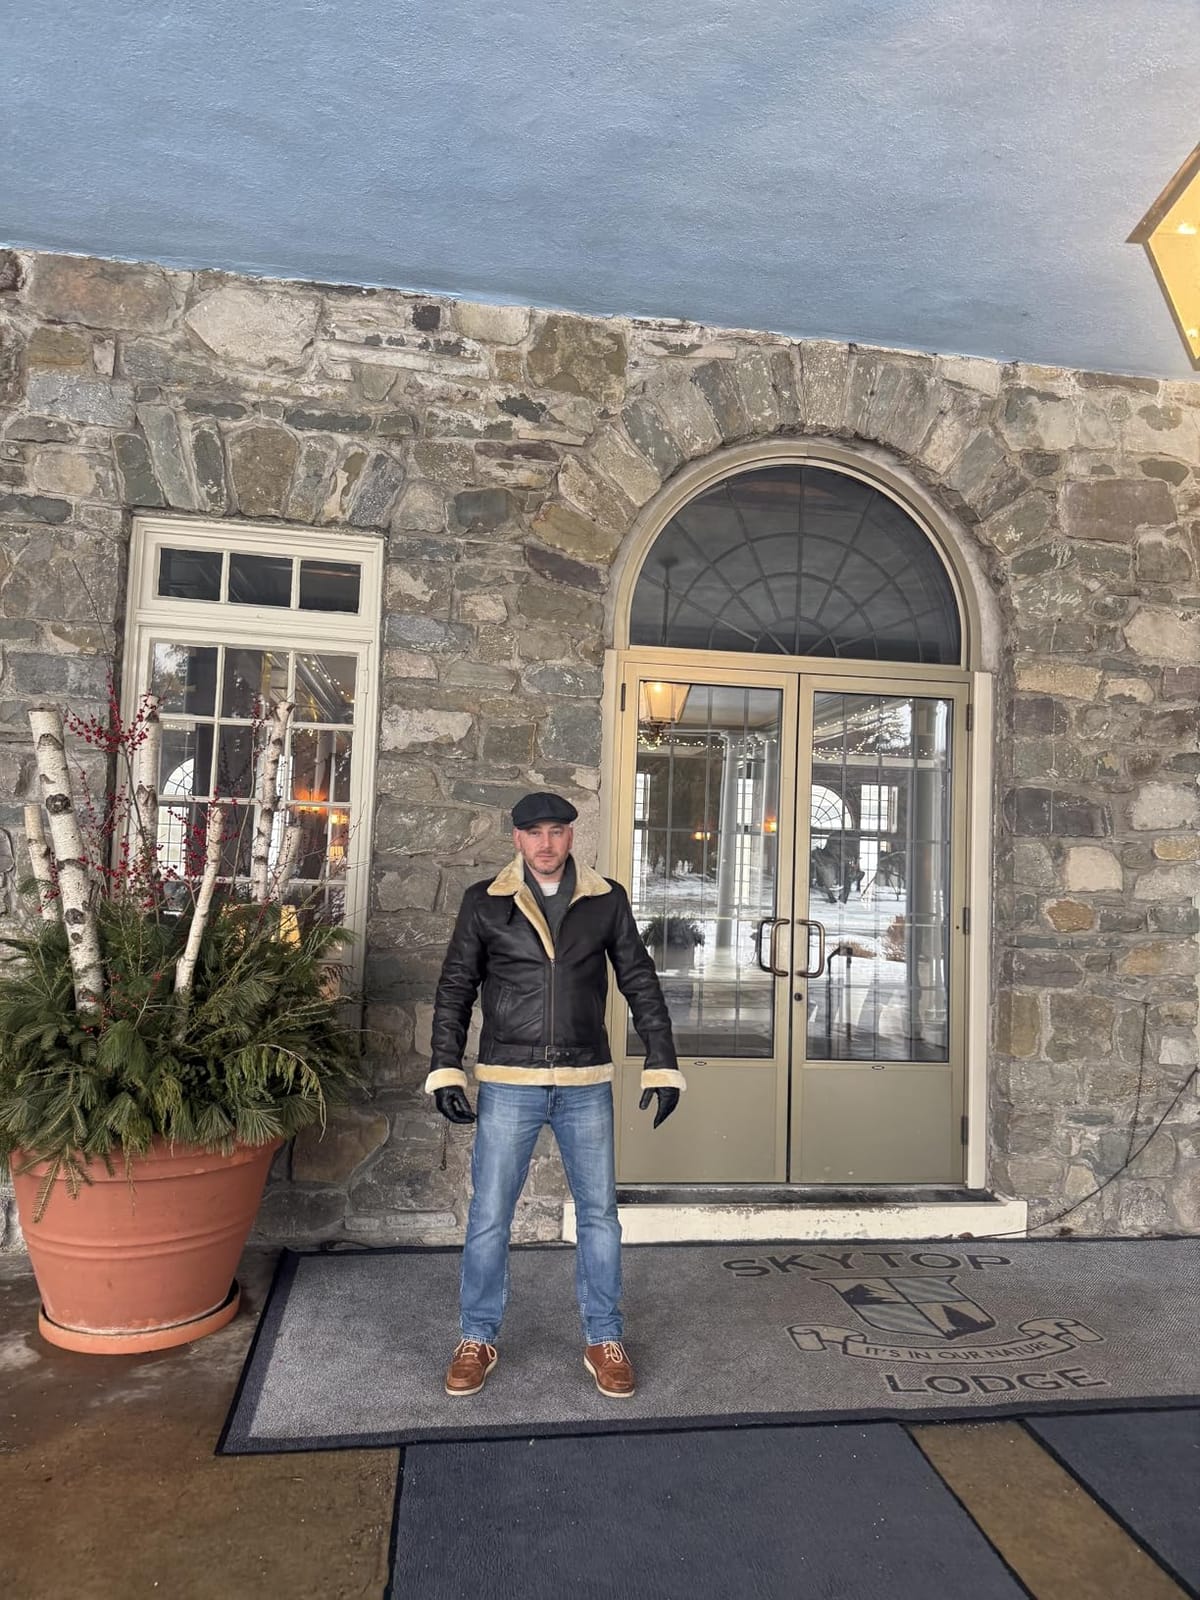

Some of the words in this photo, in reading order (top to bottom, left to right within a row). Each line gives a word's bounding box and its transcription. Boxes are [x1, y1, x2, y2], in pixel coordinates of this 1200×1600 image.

[723, 1252, 1011, 1276] SKYTOP
[865, 1346, 899, 1358] IT'S
[909, 1350, 932, 1360] IN
[938, 1350, 985, 1361] OUR
[987, 1341, 1052, 1360] NATURE
[885, 1368, 1106, 1394] LODGE
